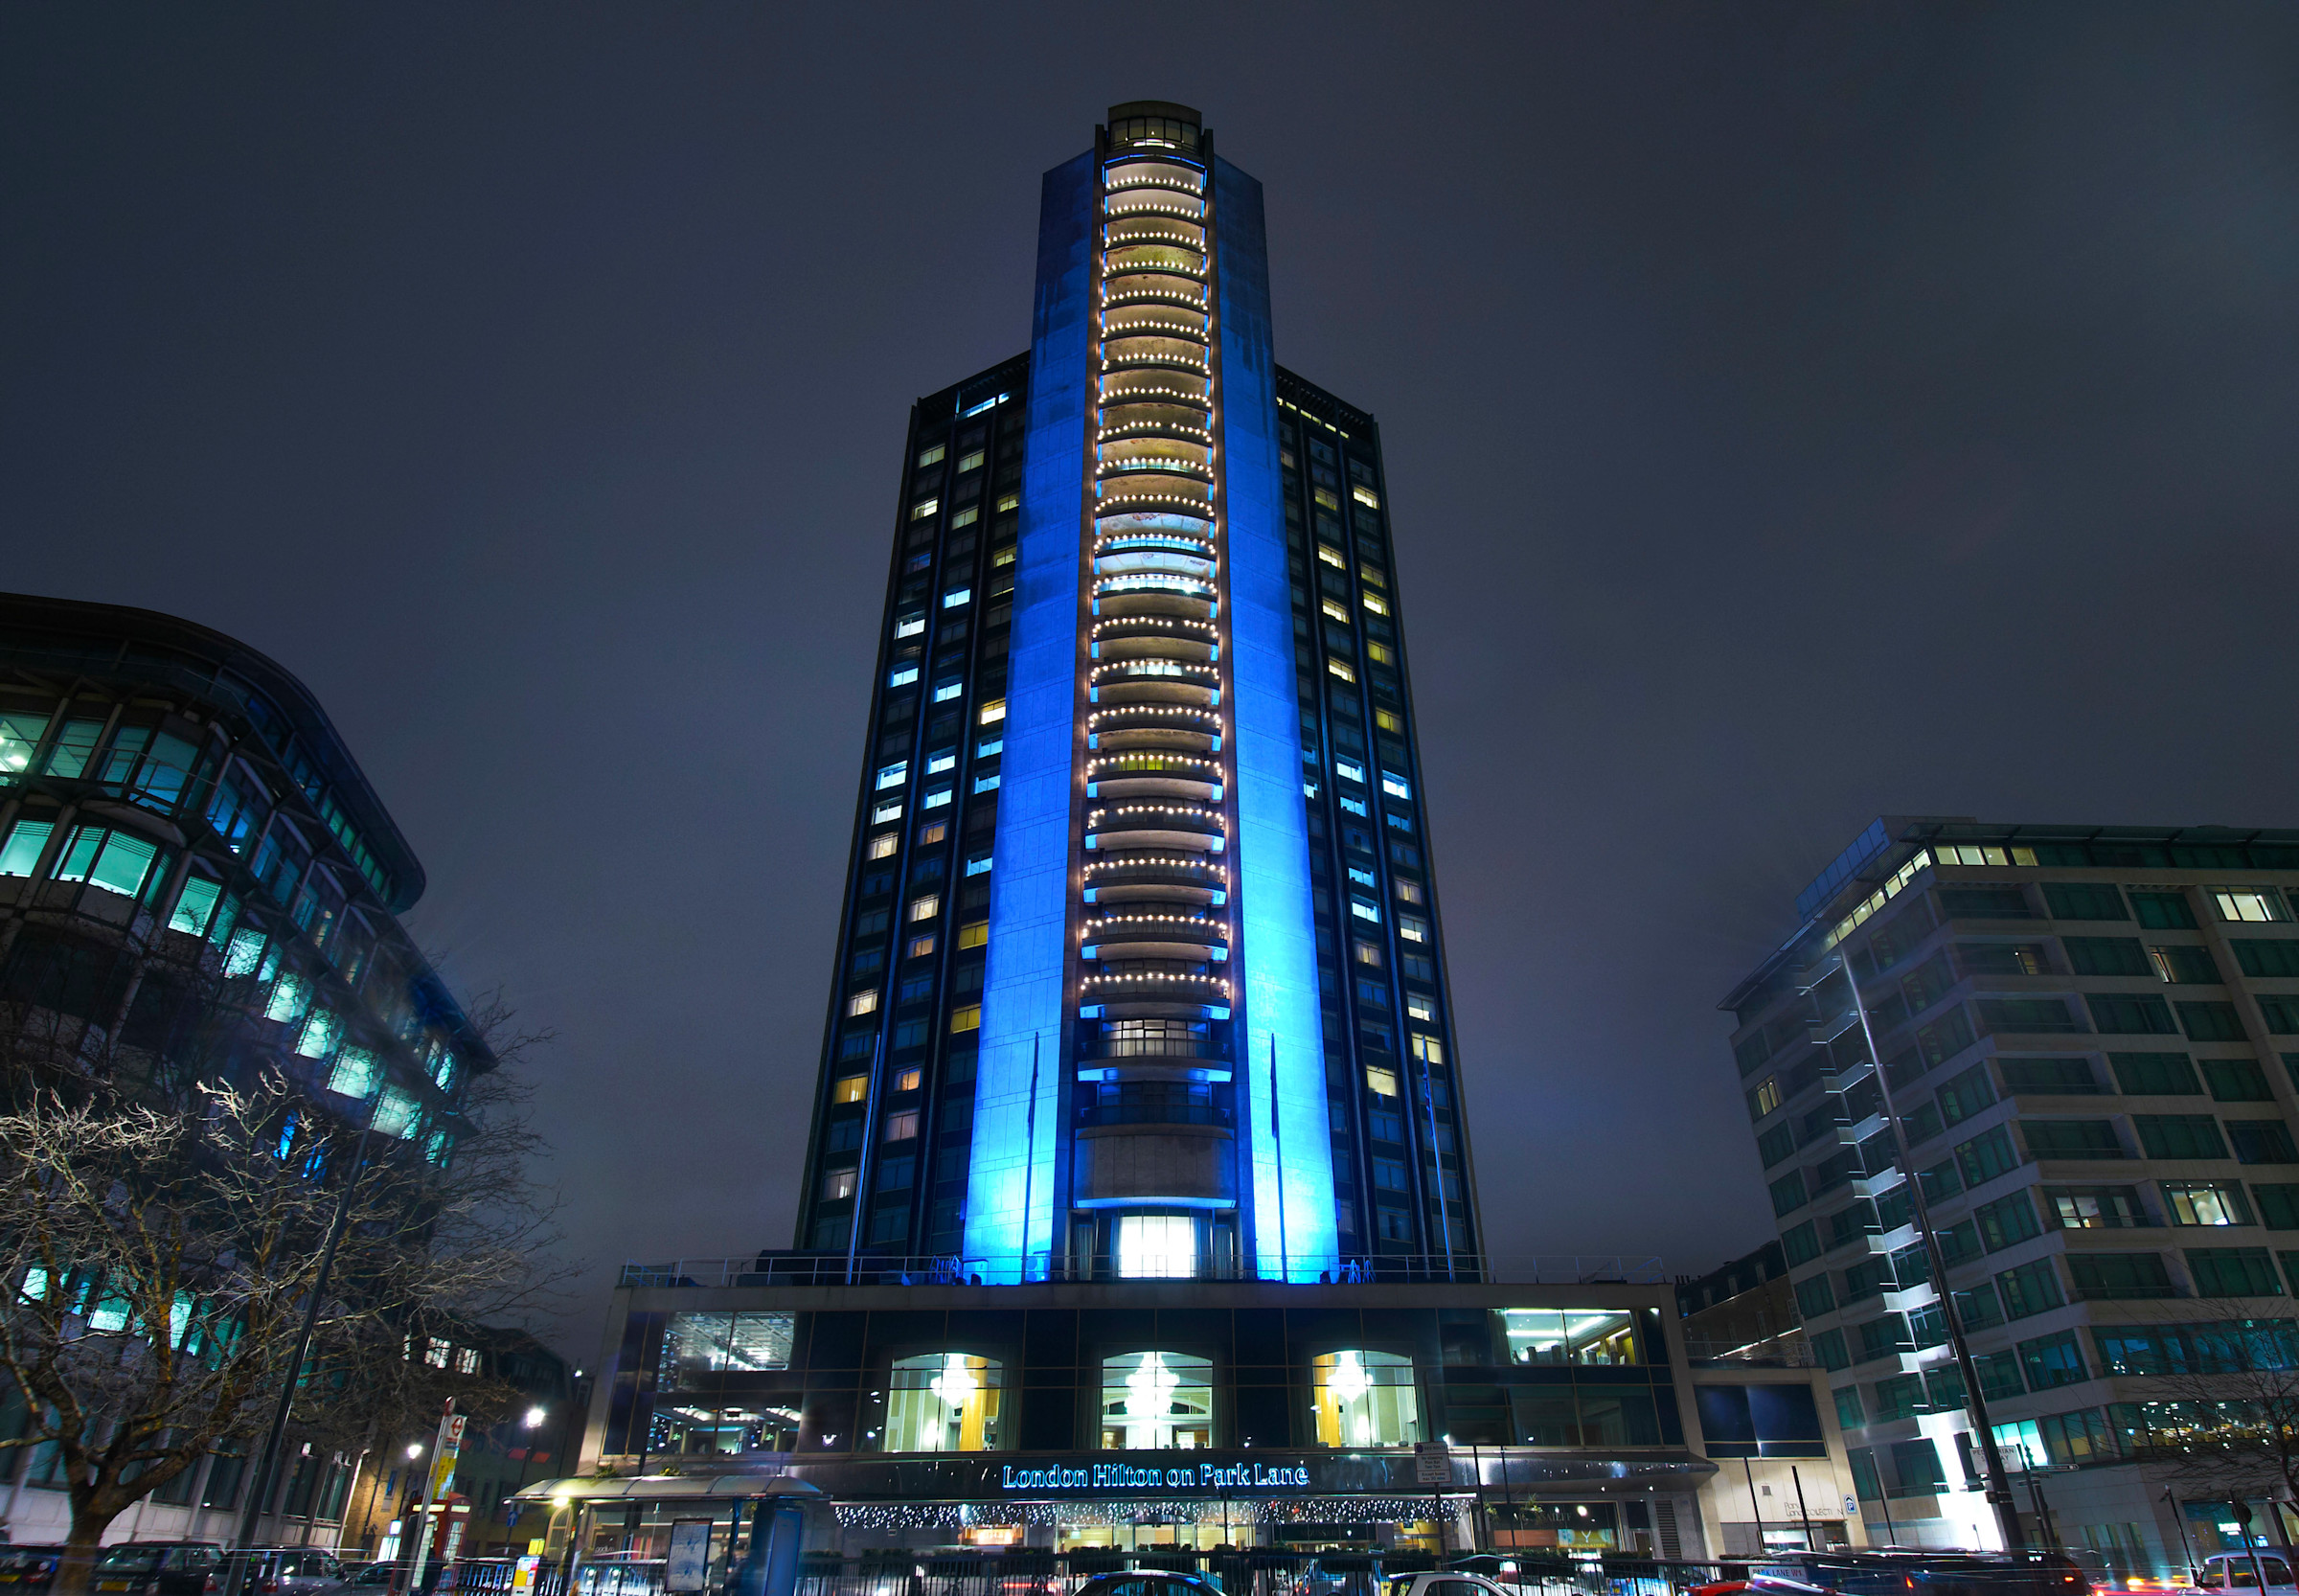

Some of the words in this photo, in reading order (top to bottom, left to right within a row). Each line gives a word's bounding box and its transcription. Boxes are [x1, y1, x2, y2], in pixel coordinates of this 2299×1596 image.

[1003, 1464, 1088, 1488] London
[1093, 1463, 1162, 1487] Hilton
[1166, 1469, 1195, 1488] on
[1199, 1462, 1250, 1488] Park
[1254, 1462, 1309, 1487] Lane
